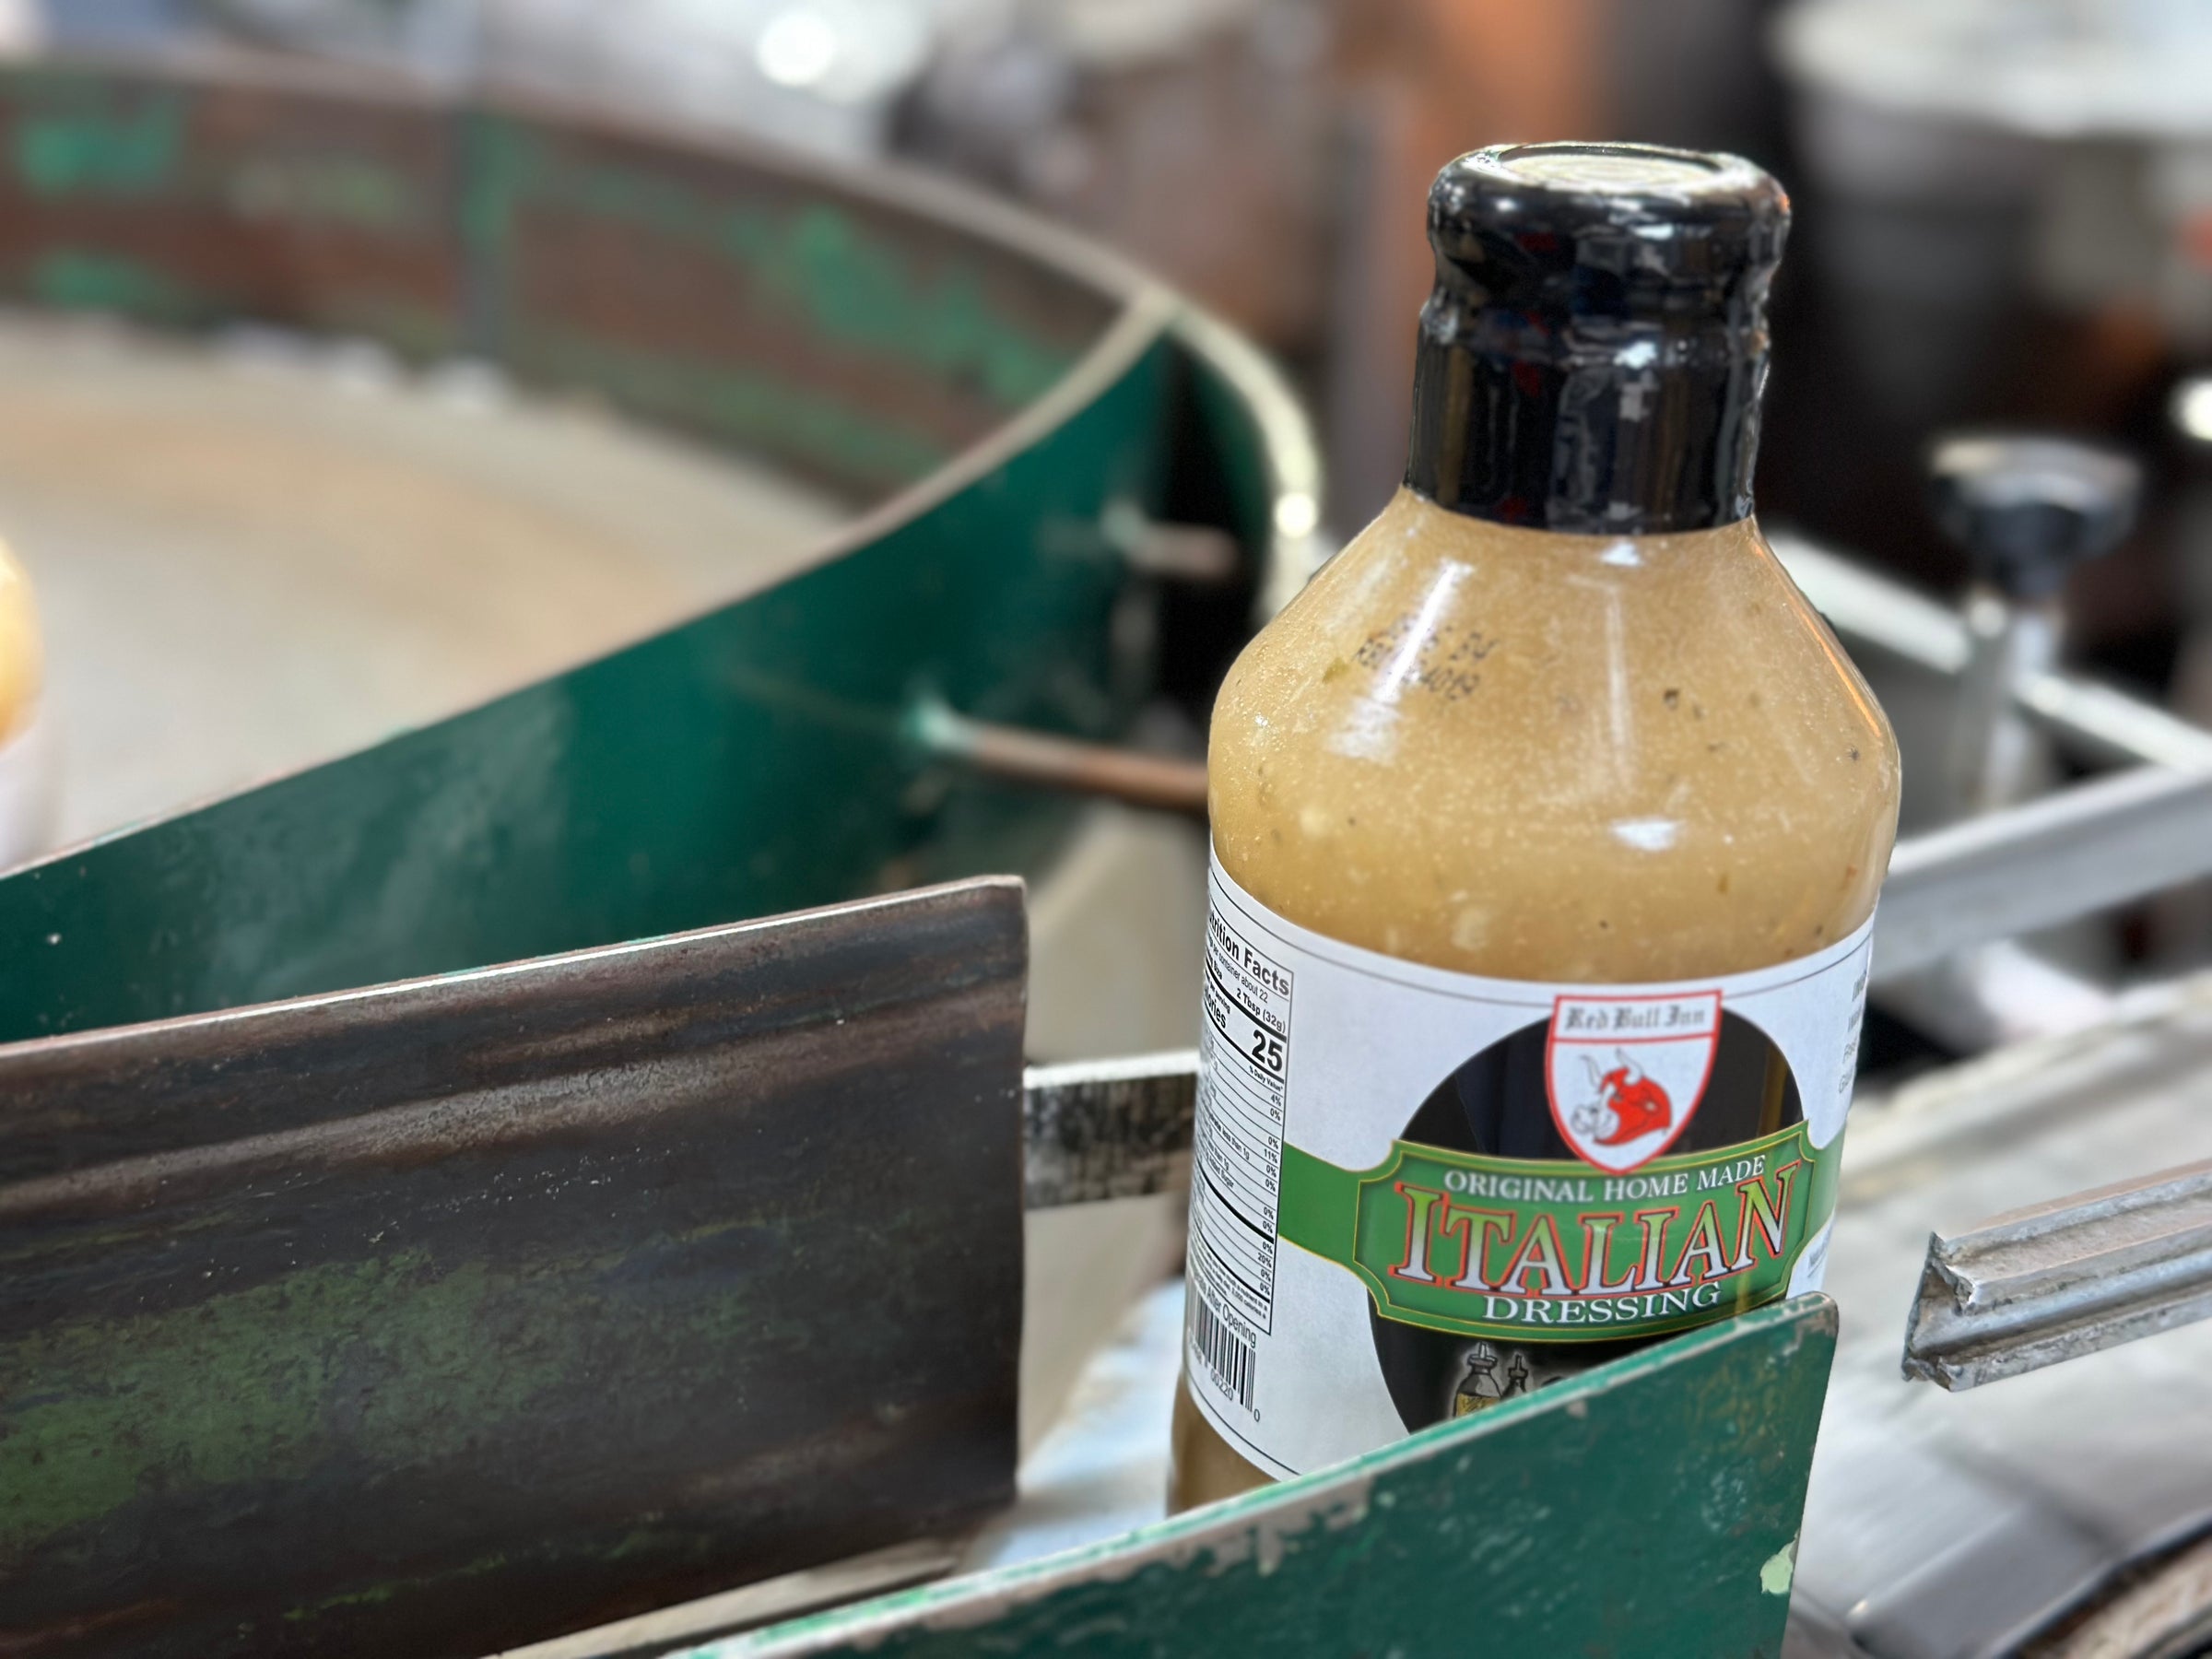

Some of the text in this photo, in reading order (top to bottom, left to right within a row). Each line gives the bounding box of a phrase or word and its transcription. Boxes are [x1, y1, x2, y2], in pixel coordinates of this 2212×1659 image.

[1244, 947, 1289, 996] Facts
[1241, 977, 1258, 996] about
[1259, 988, 1268, 1004] 22
[1236, 988, 1241, 999] 2
[1242, 993, 1261, 1016] Tbsp
[1263, 1009, 1286, 1033] (32g)
[1565, 1004, 1705, 1030] Red Bull Inn
[1252, 1030, 1283, 1072] 25
[1253, 1068, 1266, 1083] Daily
[1271, 1094, 1282, 1107] 4%
[1270, 1108, 1281, 1122] 0%
[1268, 1135, 1278, 1150] 0%
[1242, 1147, 1250, 1161] 1g
[1266, 1164, 1277, 1178] 0%
[1264, 1148, 1277, 1164] 11%
[1265, 1179, 1276, 1192] 0%
[1443, 1155, 1766, 1204] ORIGINAL HOME MADE
[1263, 1206, 1274, 1220] 0%
[1263, 1220, 1273, 1234] 0%
[1387, 1159, 1802, 1300] ITALIAN
[1263, 1241, 1273, 1254] 0%
[1257, 1253, 1272, 1268] 20%
[1261, 1269, 1271, 1282] 0%
[1259, 1282, 1270, 1296] 0%
[1482, 1281, 1722, 1324] DRESSING
[1206, 1287, 1222, 1313] After
[1222, 1303, 1256, 1348] Opening
[1210, 1369, 1261, 1422] 00220 0
